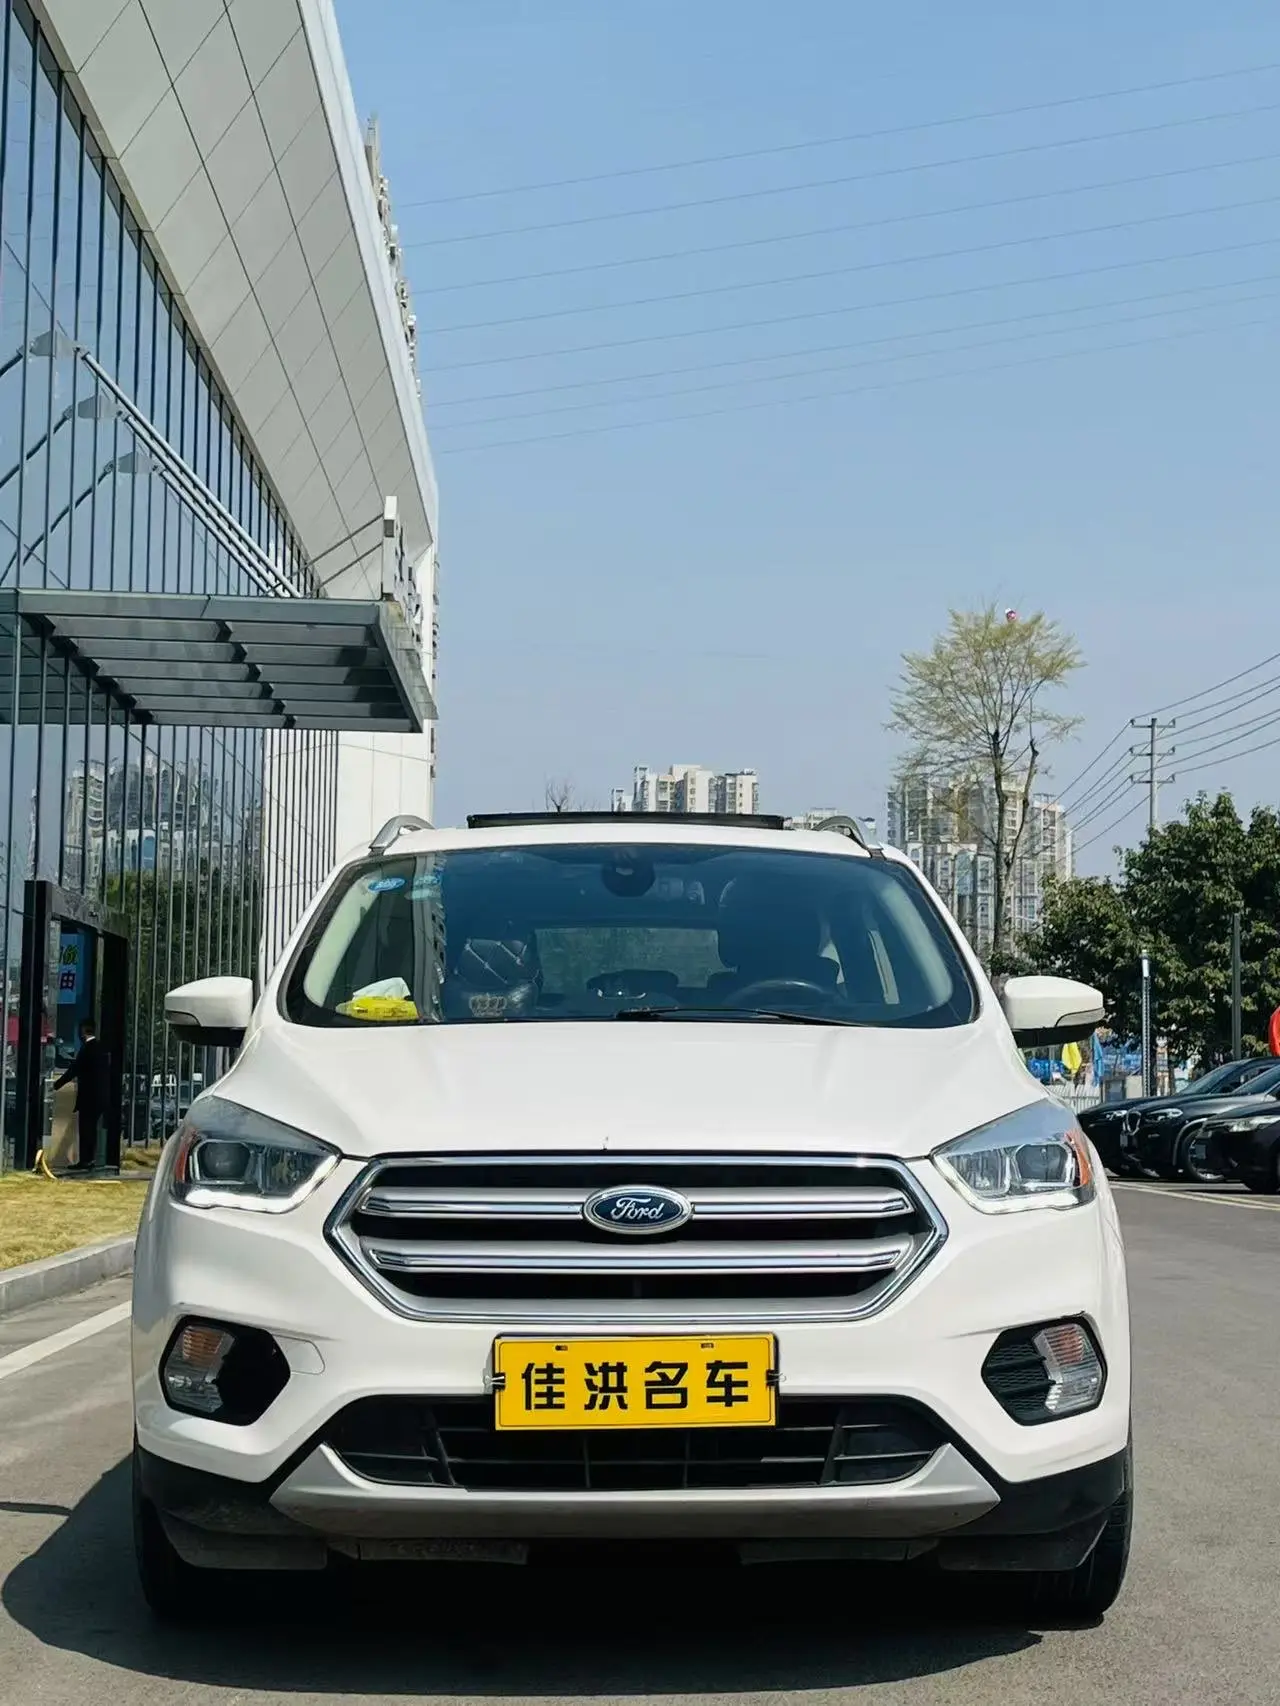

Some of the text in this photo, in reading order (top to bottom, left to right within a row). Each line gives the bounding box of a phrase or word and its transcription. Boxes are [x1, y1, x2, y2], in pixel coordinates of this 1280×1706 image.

[610, 1197, 665, 1220] Ford
[521, 1360, 749, 1410] 佳洪名车
